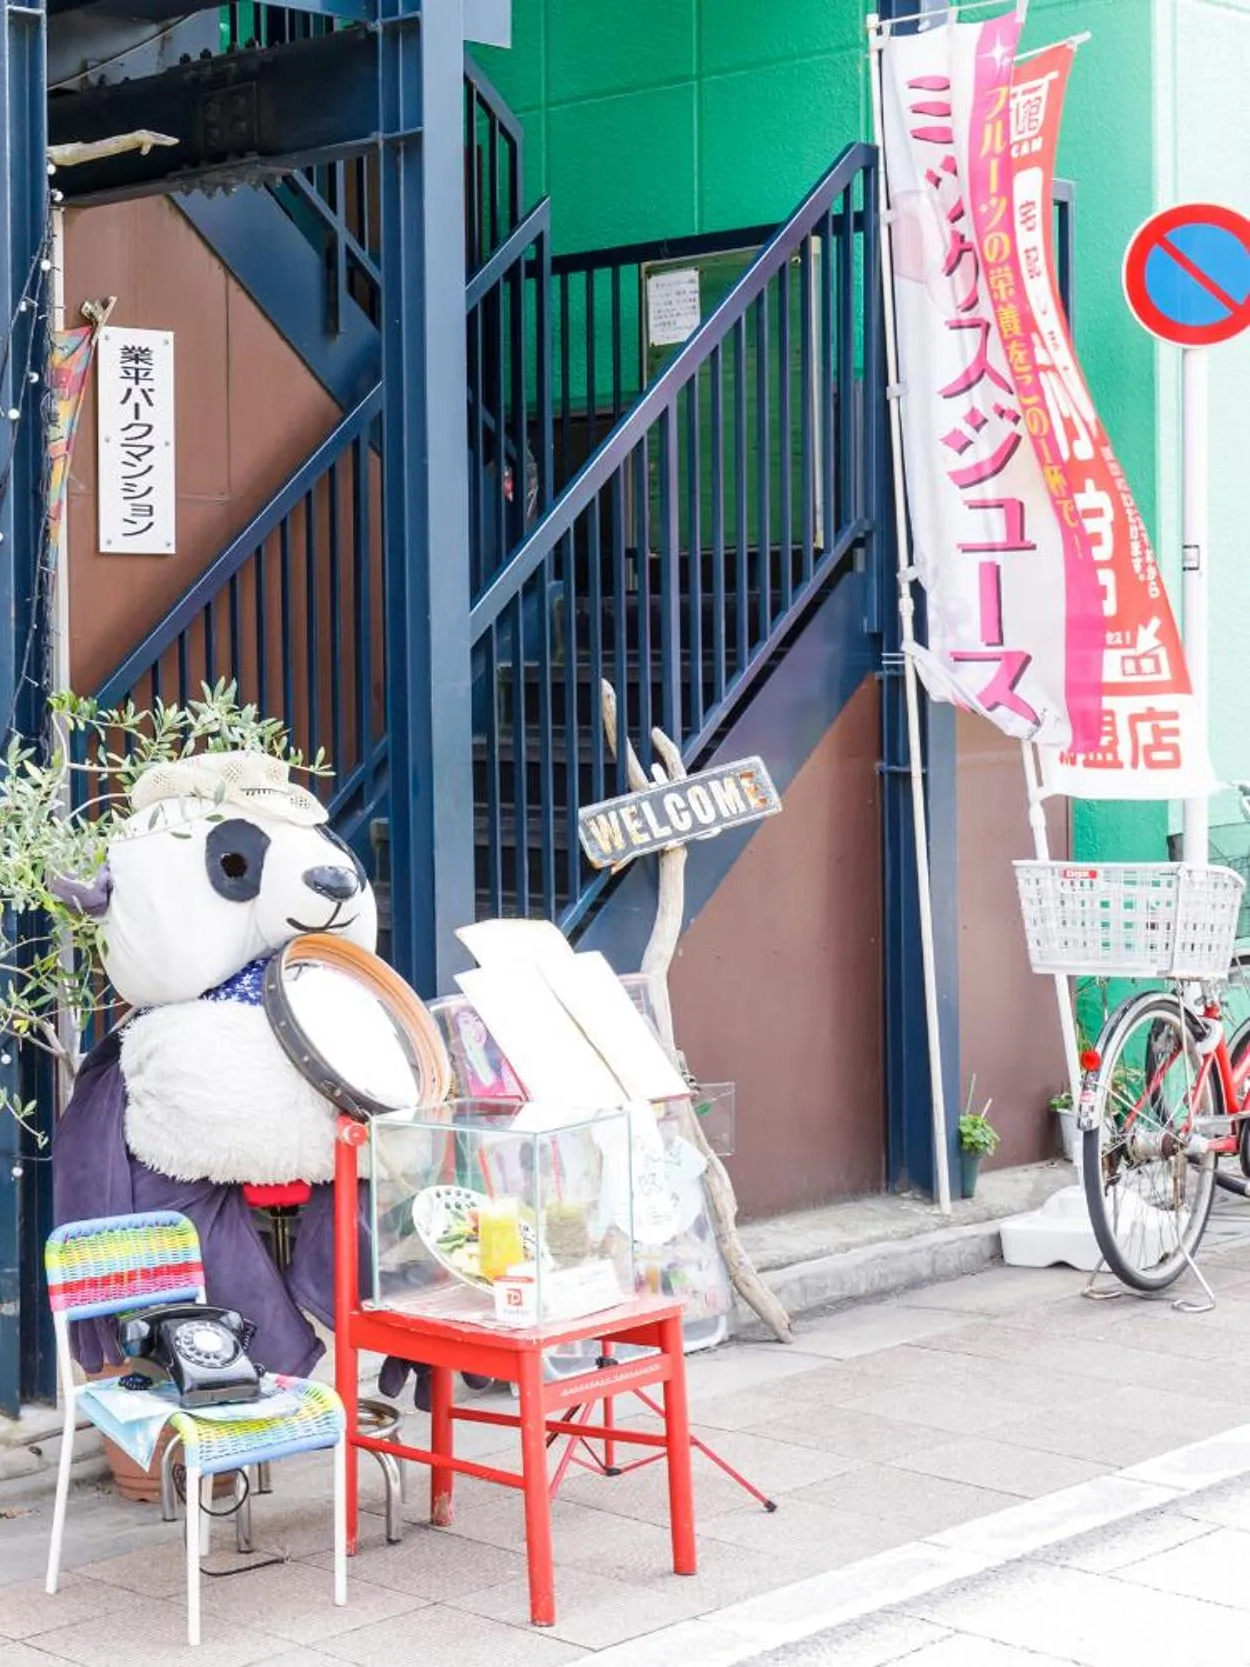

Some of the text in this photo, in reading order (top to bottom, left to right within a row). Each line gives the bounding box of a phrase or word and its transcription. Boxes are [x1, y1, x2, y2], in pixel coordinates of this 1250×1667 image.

[119, 345, 155, 538] 業平パークマンション
[906, 74, 1041, 727] ミックスジュース
[586, 770, 769, 854] WELCOME
